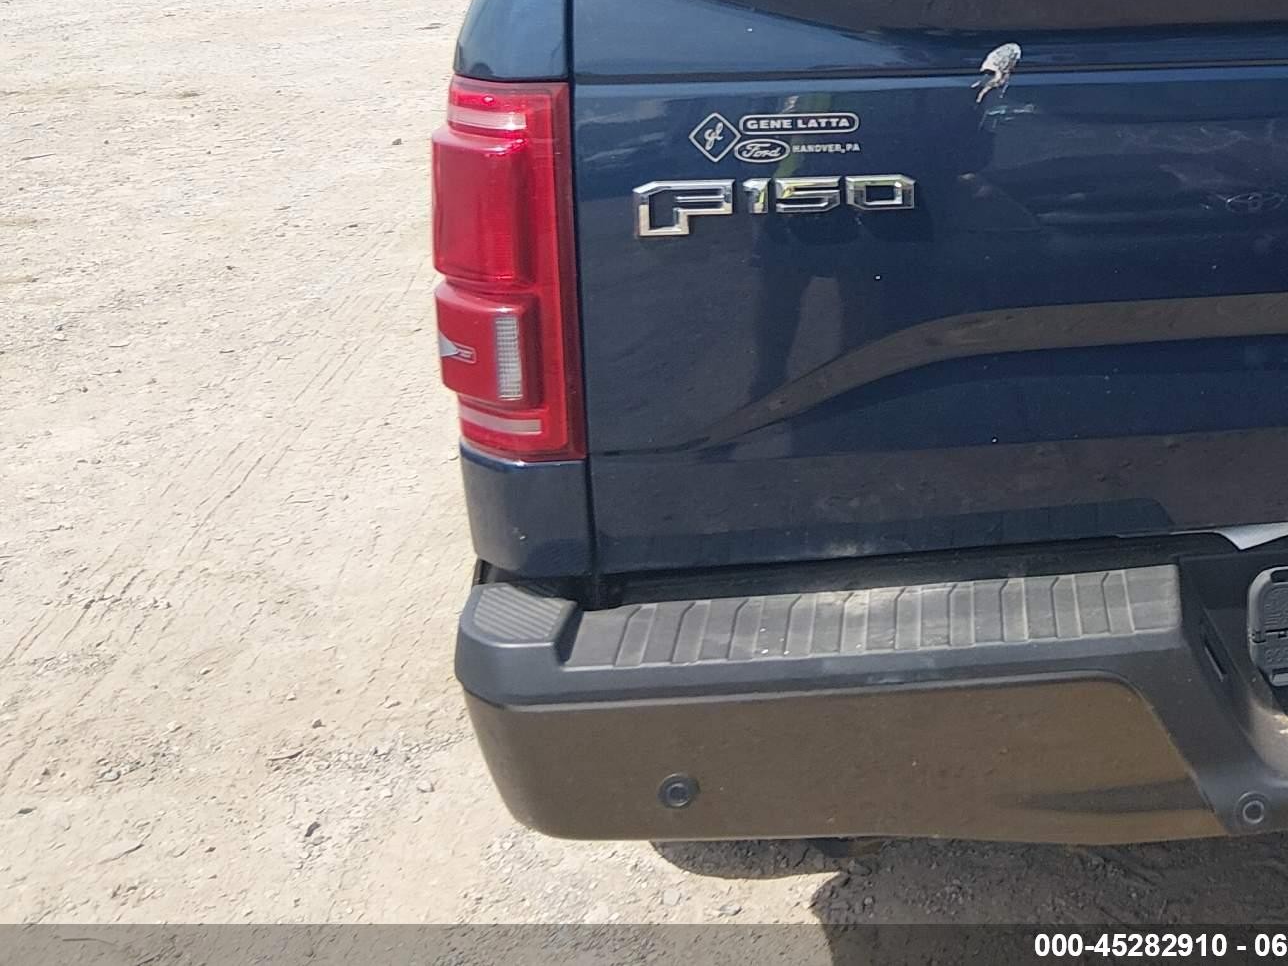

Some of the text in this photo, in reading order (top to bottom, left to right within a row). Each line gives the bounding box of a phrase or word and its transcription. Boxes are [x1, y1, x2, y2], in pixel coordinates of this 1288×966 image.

[747, 118, 850, 129] GENE LATTA
[741, 143, 782, 158] Ford
